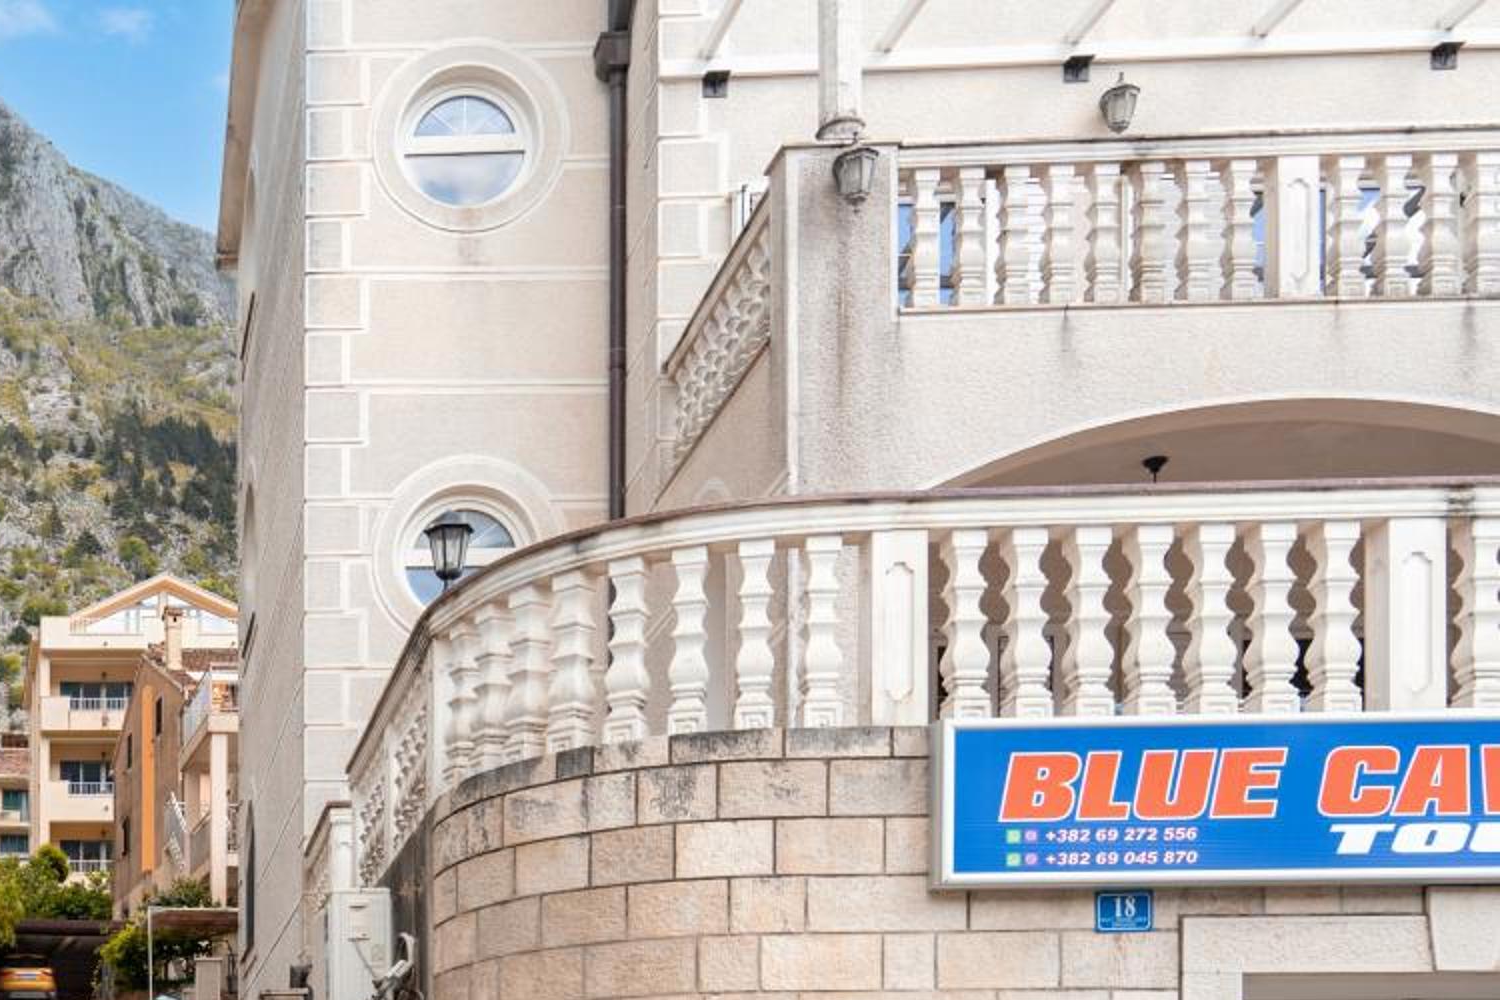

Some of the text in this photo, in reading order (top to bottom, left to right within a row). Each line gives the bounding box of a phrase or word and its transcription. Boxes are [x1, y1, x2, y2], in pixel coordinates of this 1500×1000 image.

[998, 747, 1288, 822] BLUE
[1046, 827, 1199, 843] +382 69 272 556
[1046, 851, 1199, 866] +382 69 045 870
[1114, 896, 1137, 917] 18
